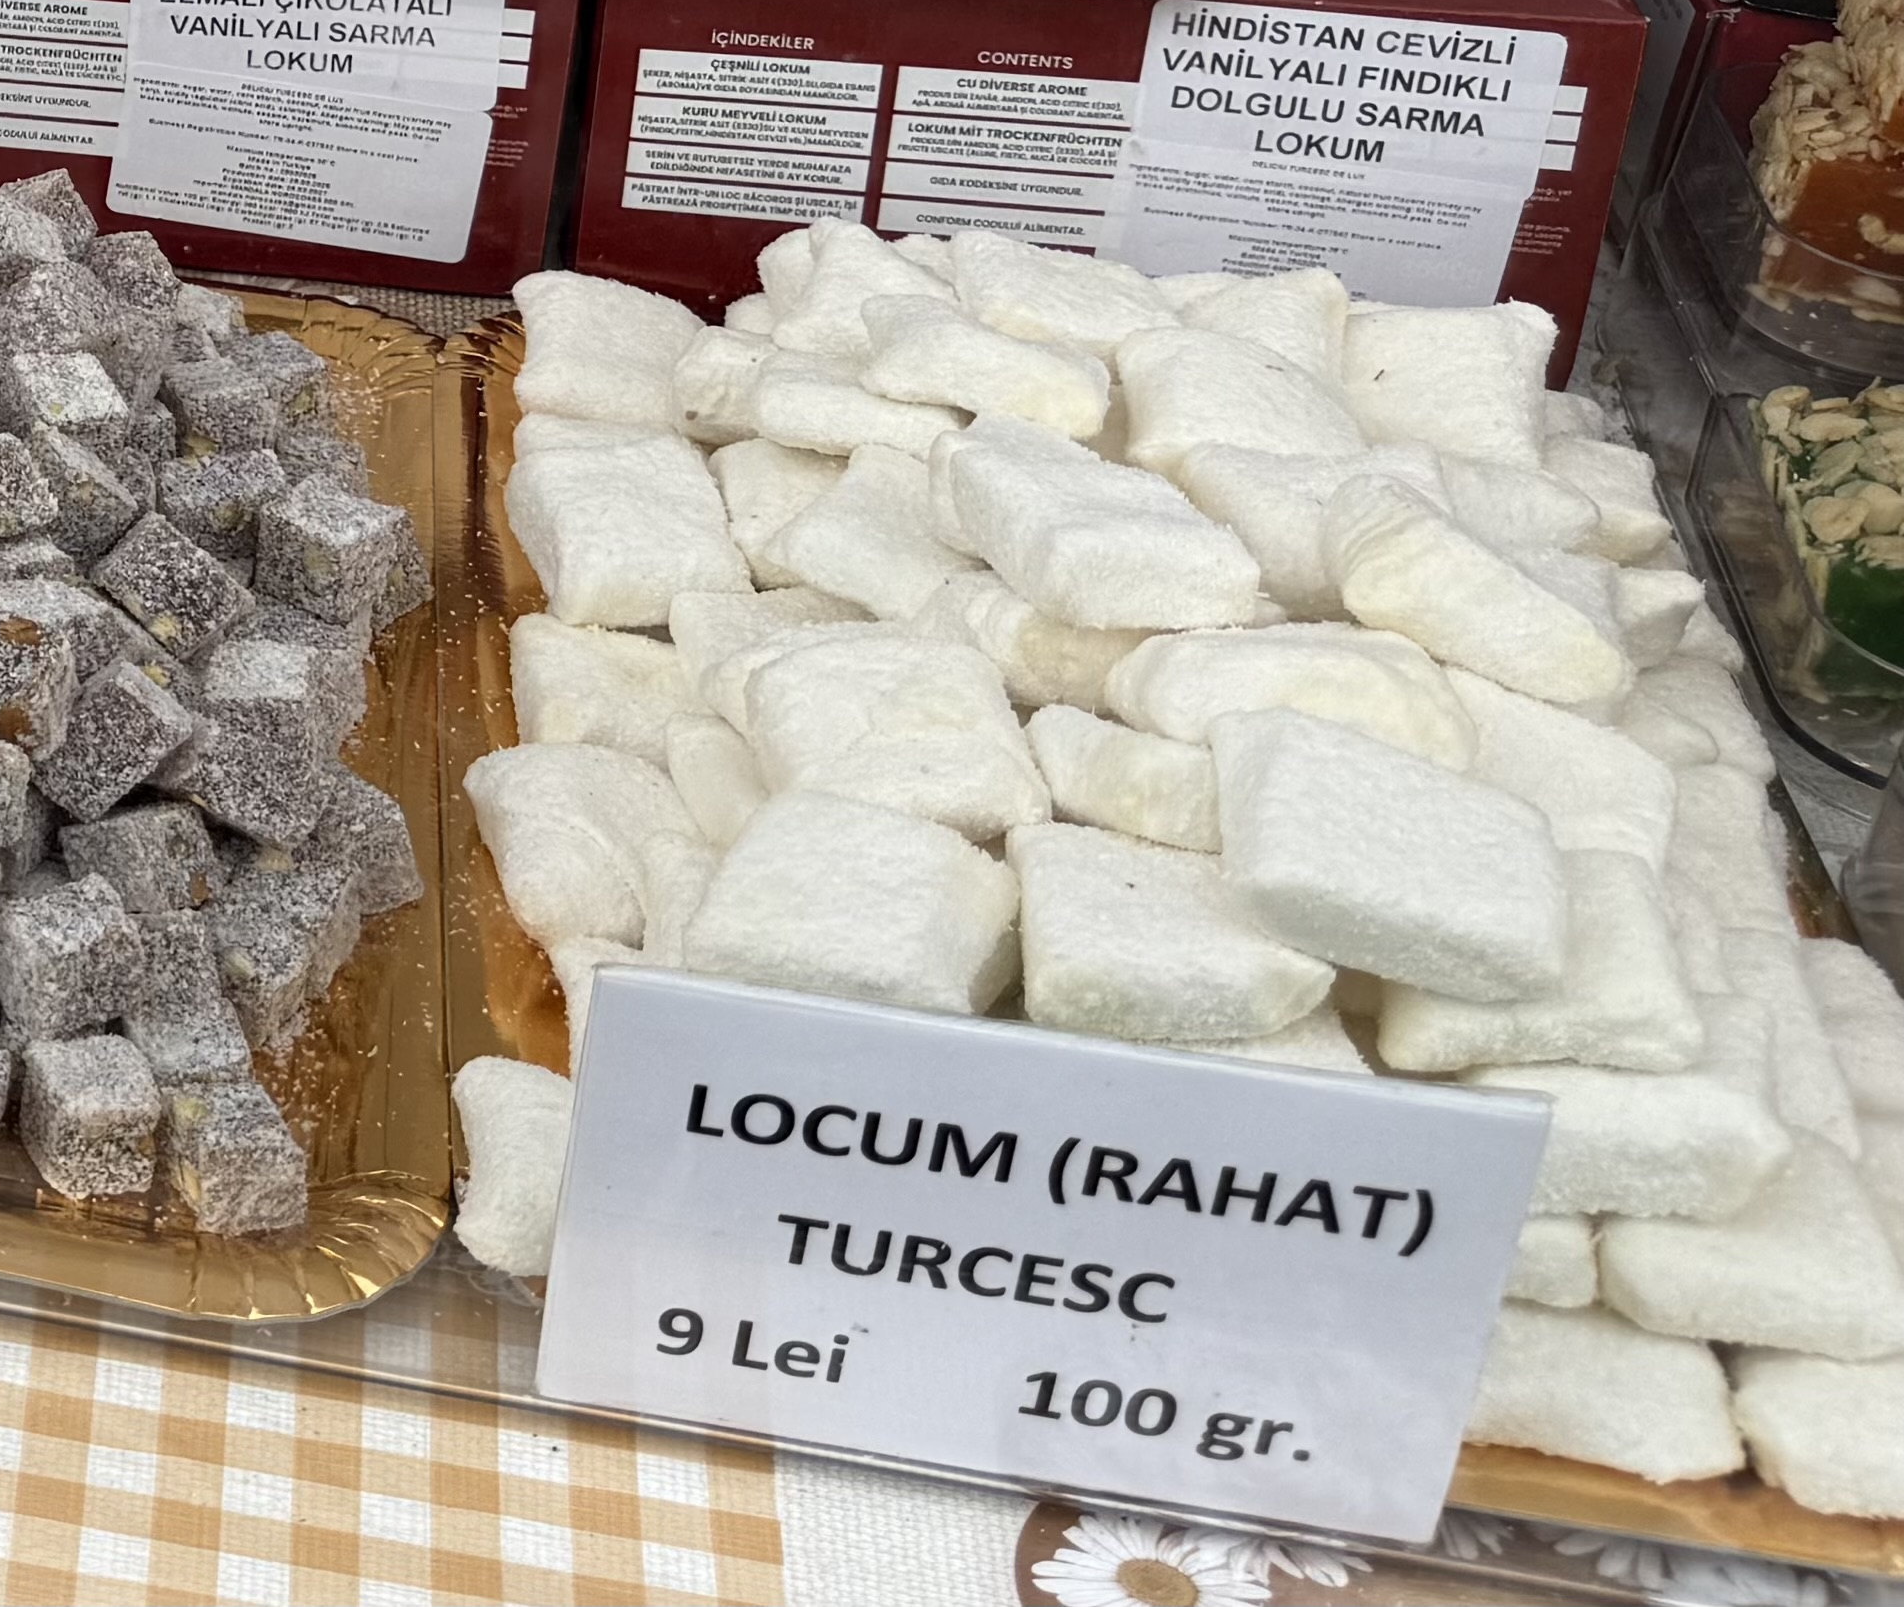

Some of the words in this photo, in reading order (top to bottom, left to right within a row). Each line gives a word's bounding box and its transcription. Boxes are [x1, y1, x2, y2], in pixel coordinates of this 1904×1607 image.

[42, 2, 88, 16] AROME
[168, 10, 320, 42] VANİLYALI
[327, 21, 437, 48] SARMA
[710, 26, 815, 54] İÇİNDEKİLER
[1170, 5, 1367, 52] HİNDİSTAN
[1374, 24, 1518, 65] CEVİZLİ
[0, 43, 123, 64] TROCKENFRÜCHTEN
[245, 48, 353, 75] LOKUM
[709, 57, 761, 74] ÇEŞNİLİ
[761, 61, 811, 75] LOKUM
[975, 50, 1075, 70] CONTENTS
[1160, 42, 1348, 87] VANİLYALI
[1356, 65, 1512, 102] FINDIKLI
[1036, 82, 1088, 97] AROME
[720, 107, 777, 122] MEYVELİ
[777, 112, 827, 126] LOKUM
[1170, 84, 1346, 124] DOLGULU
[1354, 101, 1489, 137] SARMA
[906, 121, 957, 136] LOKUM
[984, 126, 1124, 148] TROCKENFRÜCHTEN
[1253, 128, 1385, 164] LOKUM
[687, 1085, 1017, 1182] LOCUM
[1048, 1136, 1435, 1259] (RAHAT)
[778, 1215, 1175, 1322] TURCESC
[658, 1309, 703, 1355] 9
[733, 1321, 849, 1382] Lei
[1019, 1372, 1176, 1435] 100
[1198, 1414, 1308, 1460] gr.
